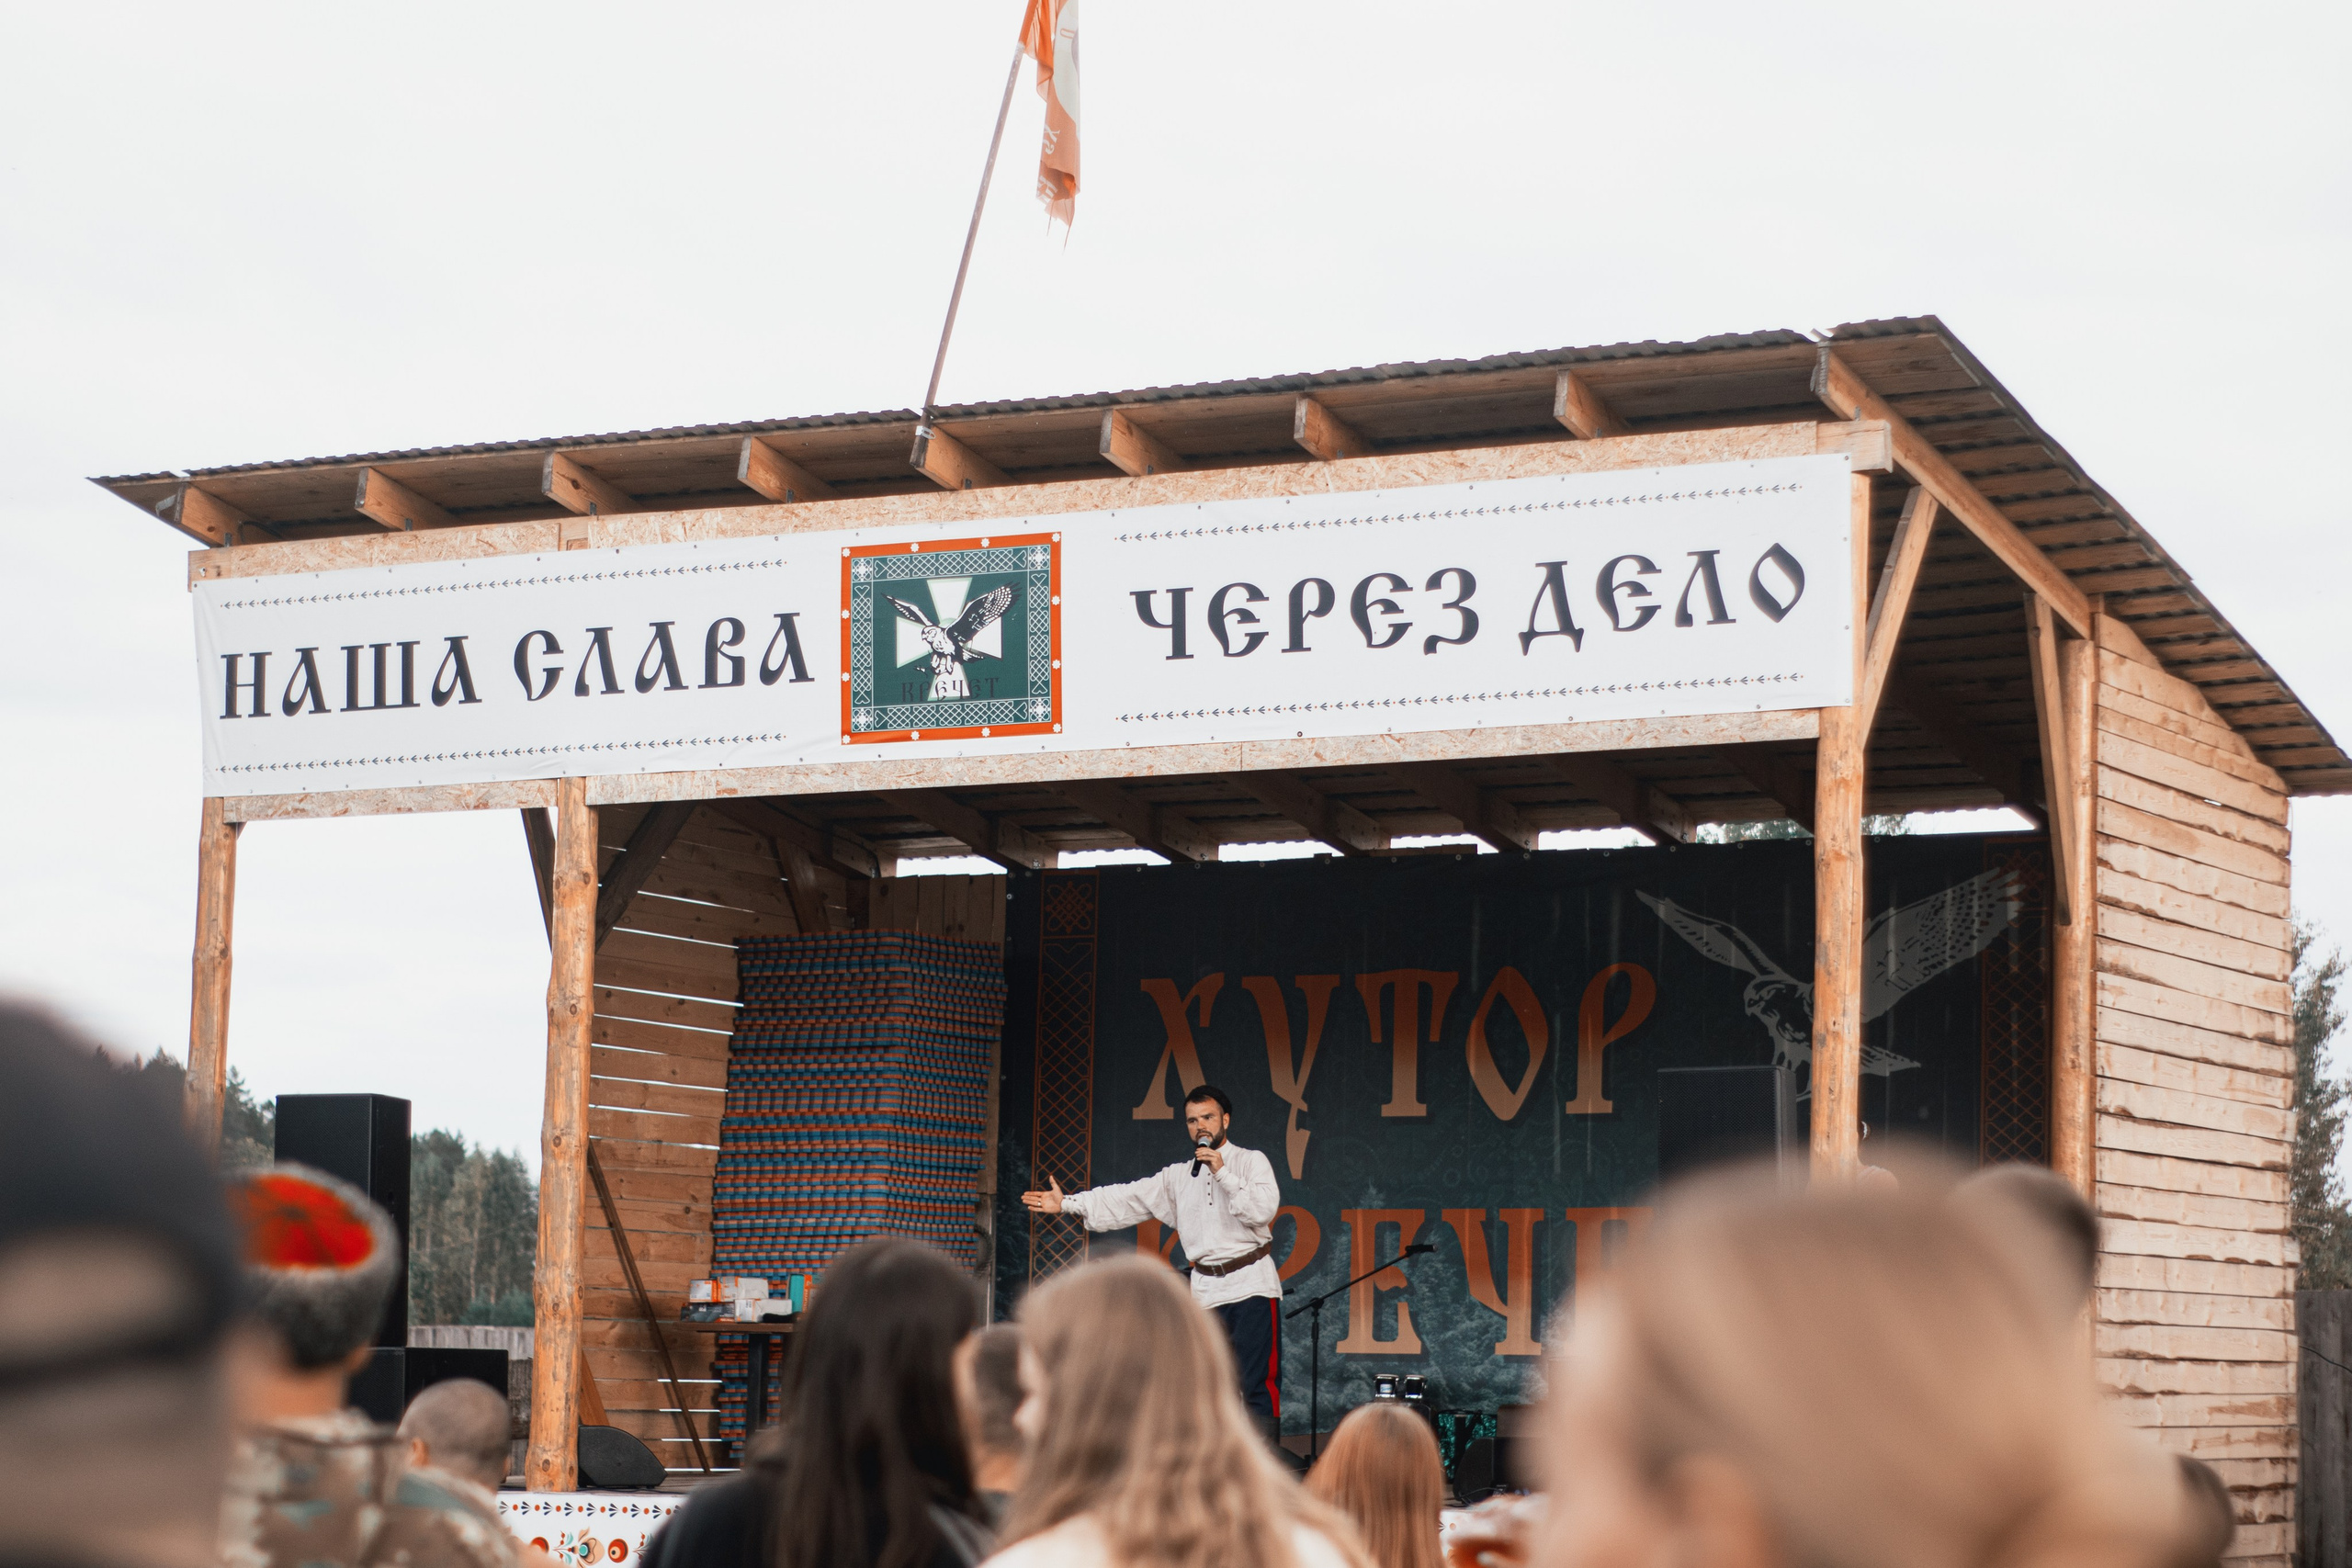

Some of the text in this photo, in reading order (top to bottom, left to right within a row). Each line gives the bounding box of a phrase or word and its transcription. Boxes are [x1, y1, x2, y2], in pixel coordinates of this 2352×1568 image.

[1129, 542, 1806, 661] ЧЕРЕЗ ДЕЛО
[220, 611, 815, 720] НАША СЛАВА
[1132, 963, 1657, 1179] ХУТОР
